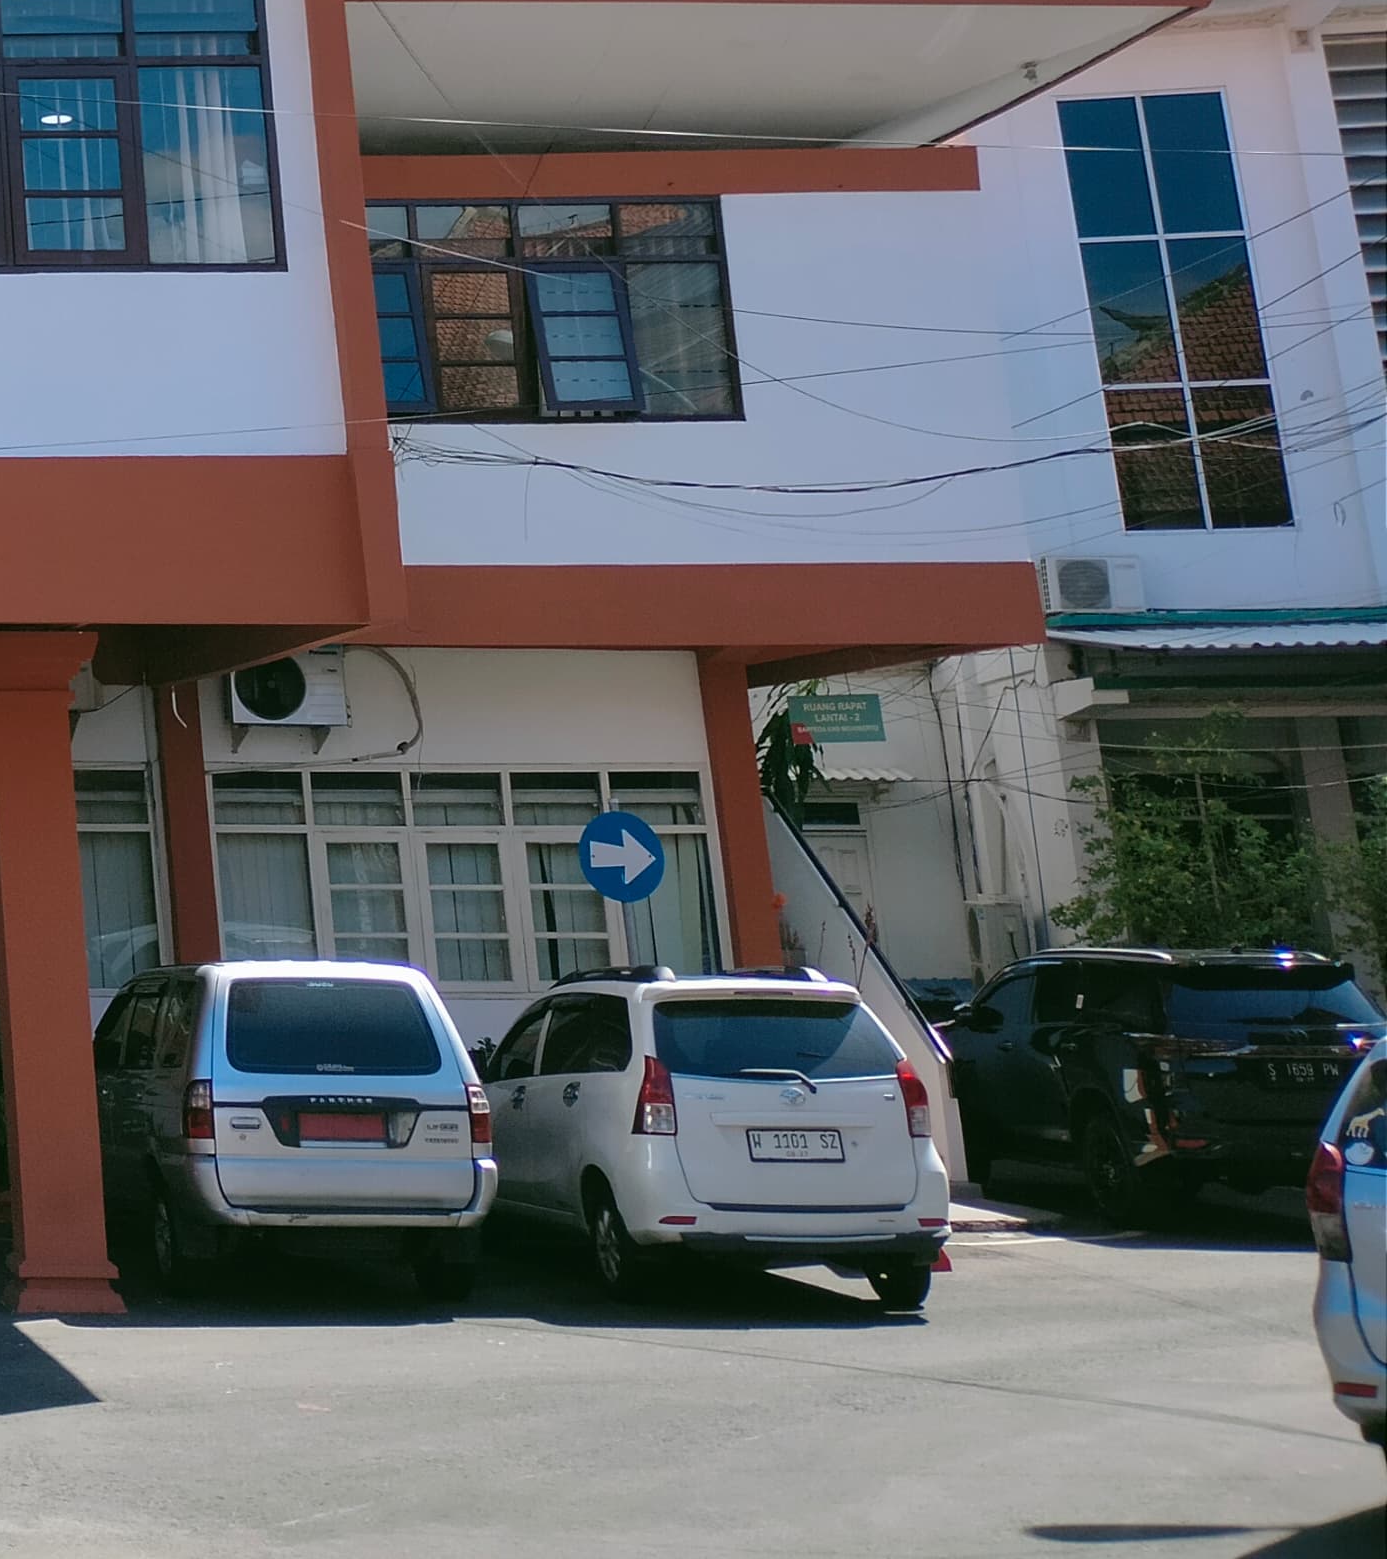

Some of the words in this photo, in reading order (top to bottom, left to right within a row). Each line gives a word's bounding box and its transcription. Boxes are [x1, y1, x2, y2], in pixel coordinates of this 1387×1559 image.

[803, 702, 836, 712] RUANG
[838, 701, 867, 711] RAPAT
[815, 713, 848, 722] LANTAI
[854, 713, 860, 721] 2
[1267, 1063, 1276, 1076] S
[1286, 1063, 1314, 1076] 1659
[1322, 1063, 1339, 1076] PW
[309, 1096, 373, 1104] PANTHER
[751, 1134, 762, 1149] W
[773, 1134, 809, 1149] 1101
[821, 1134, 839, 1149] SZ
